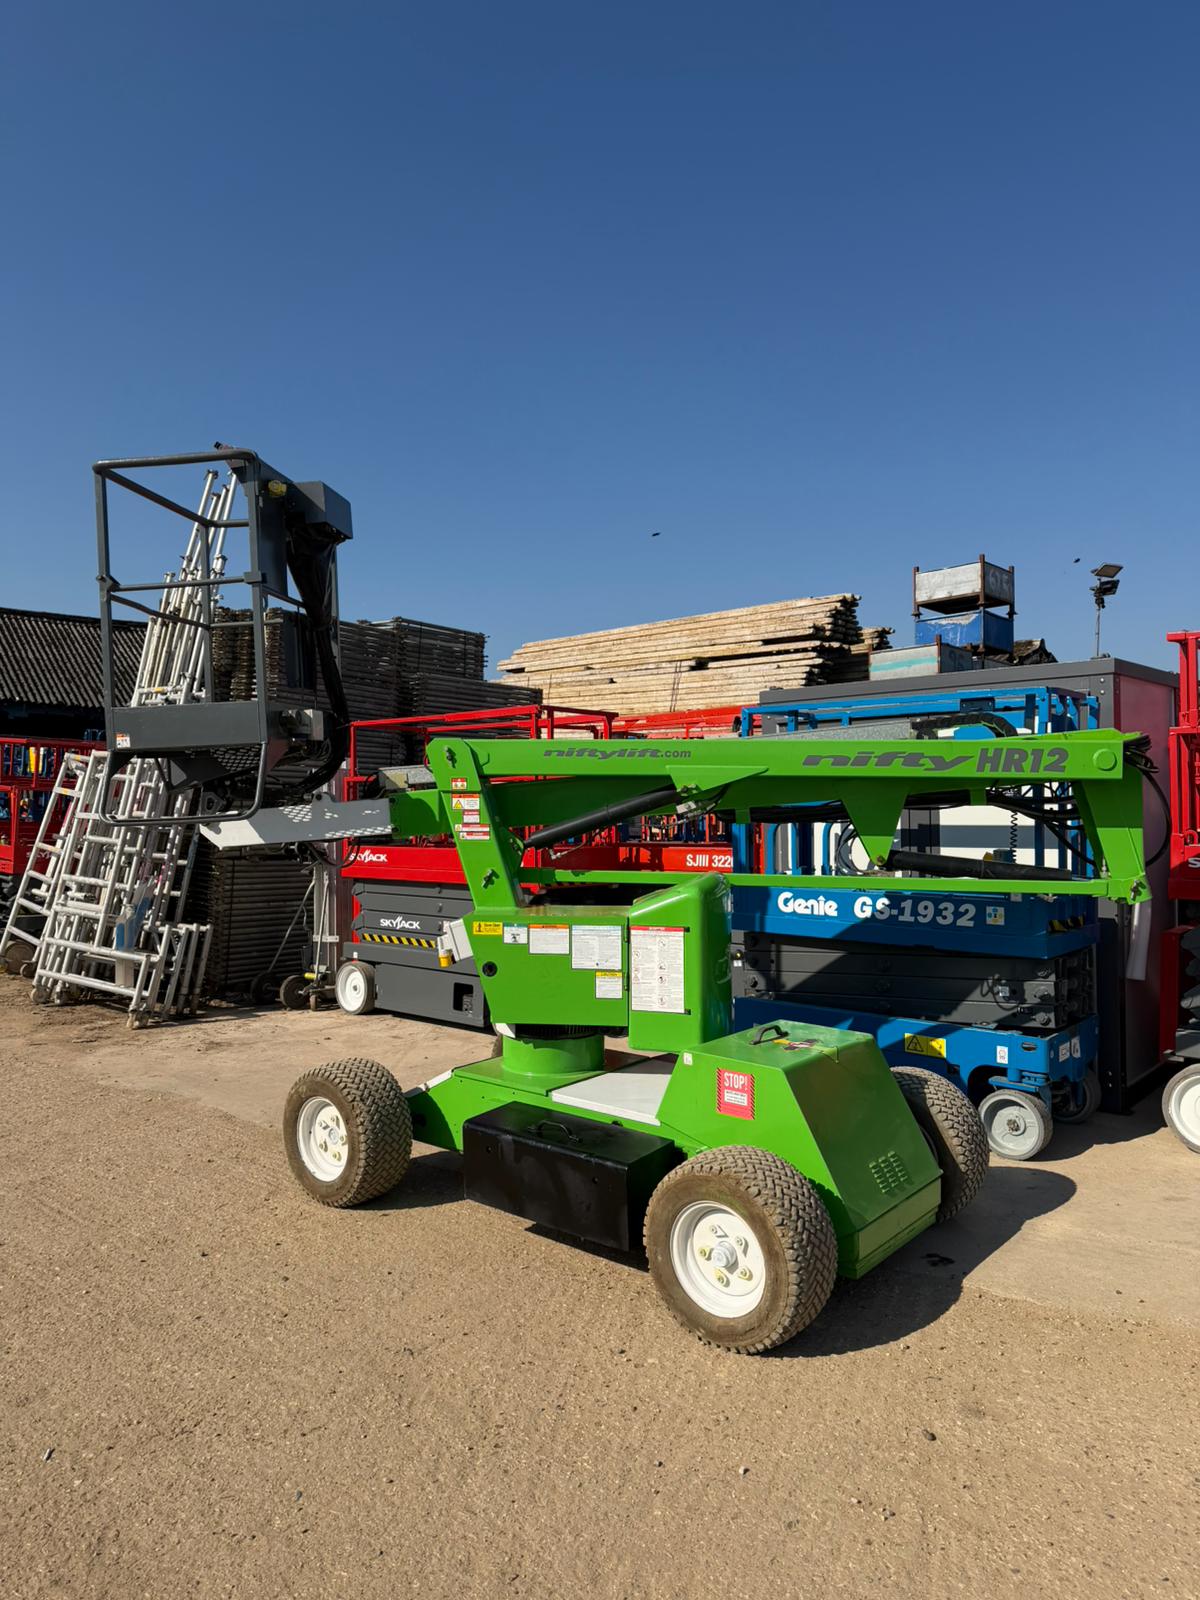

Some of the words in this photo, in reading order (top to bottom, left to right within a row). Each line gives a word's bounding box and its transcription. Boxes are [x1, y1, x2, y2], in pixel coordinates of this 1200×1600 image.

[543, 748, 691, 760] niftylift.com
[802, 751, 975, 771] nifty
[976, 747, 1069, 774] HR12
[686, 854, 709, 867] SJIII
[711, 855, 733, 868] 322
[777, 891, 838, 917] Genie
[854, 896, 976, 927] GS-1932
[380, 915, 421, 930] SKYJACK
[724, 1071, 748, 1091] STOP!
